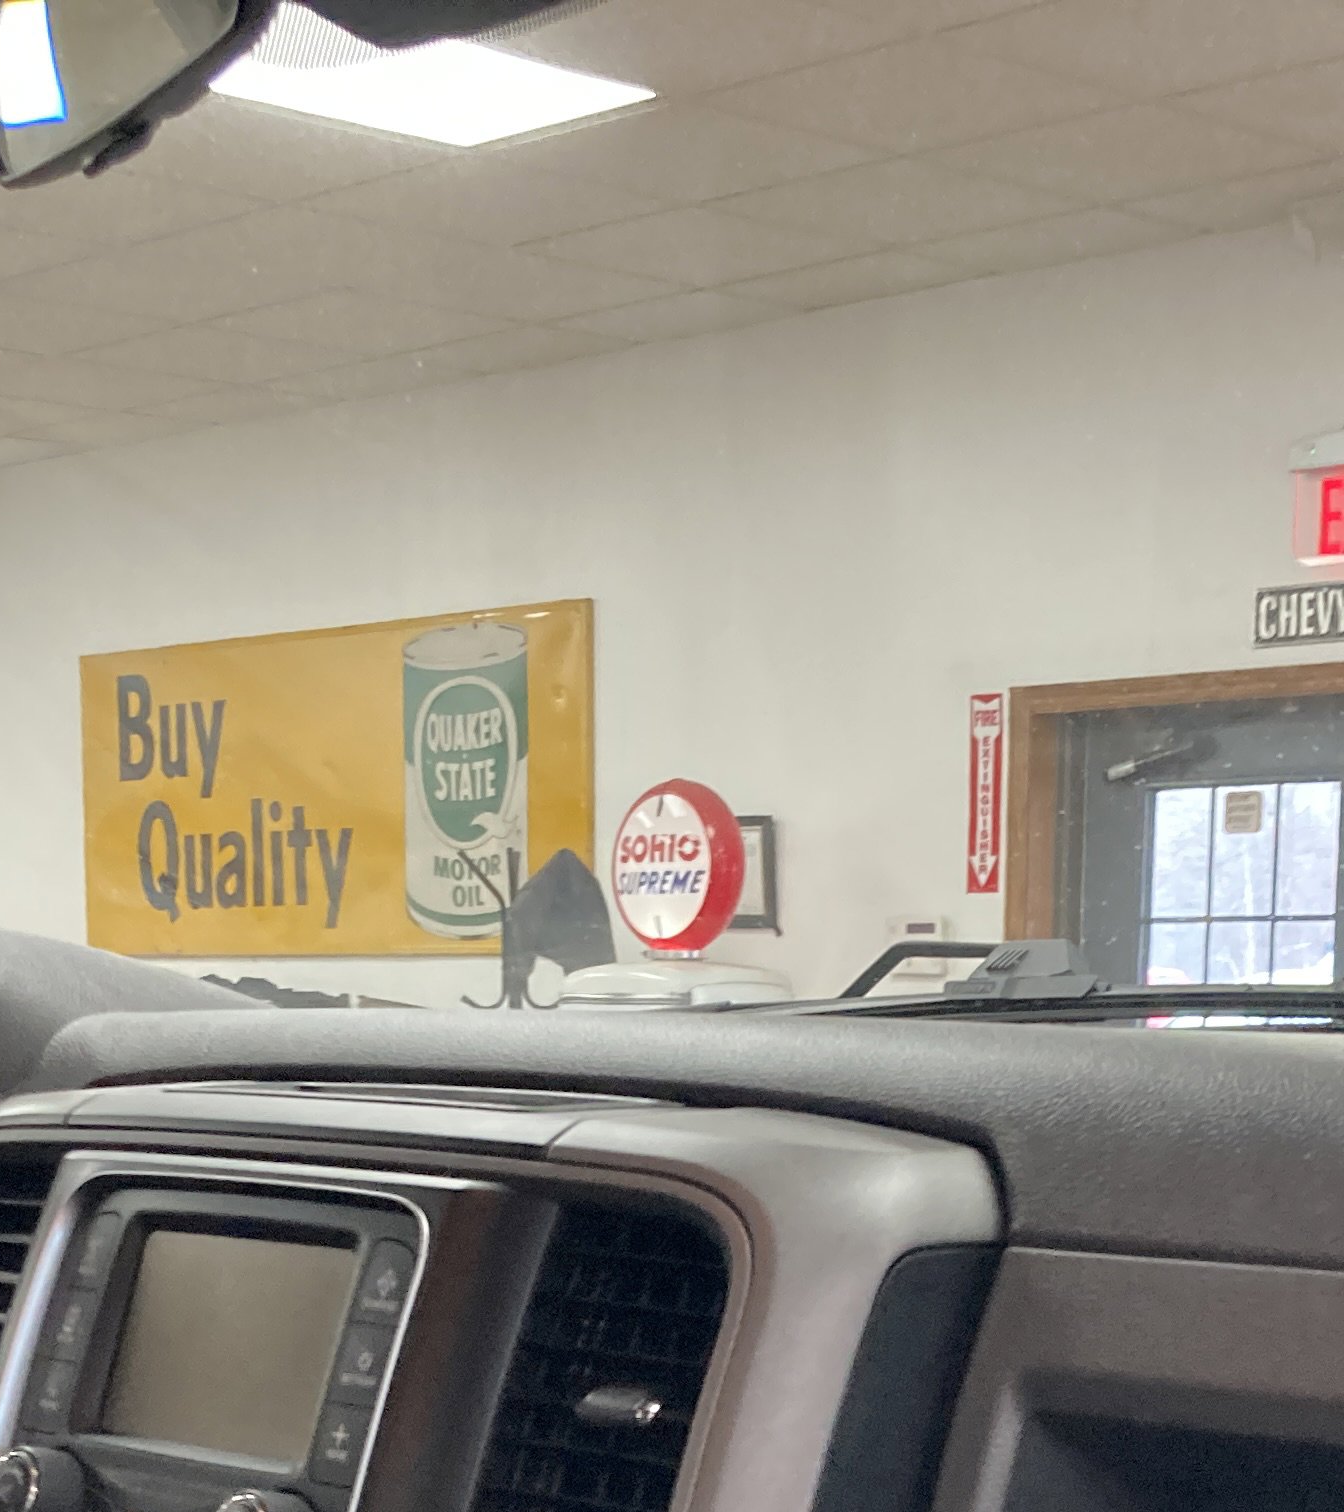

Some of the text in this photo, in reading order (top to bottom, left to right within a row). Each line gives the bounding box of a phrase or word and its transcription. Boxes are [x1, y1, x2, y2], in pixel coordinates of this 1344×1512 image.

[117, 674, 227, 798] Buy
[426, 707, 503, 753] QUAKER
[975, 710, 999, 726] FIRE
[434, 758, 496, 801] STATE
[978, 736, 992, 875] EXTINGUISHER
[137, 798, 354, 929] Quality
[620, 834, 701, 863] SOHIO
[452, 885, 485, 907] OIL
[618, 870, 706, 894] SUPREME
